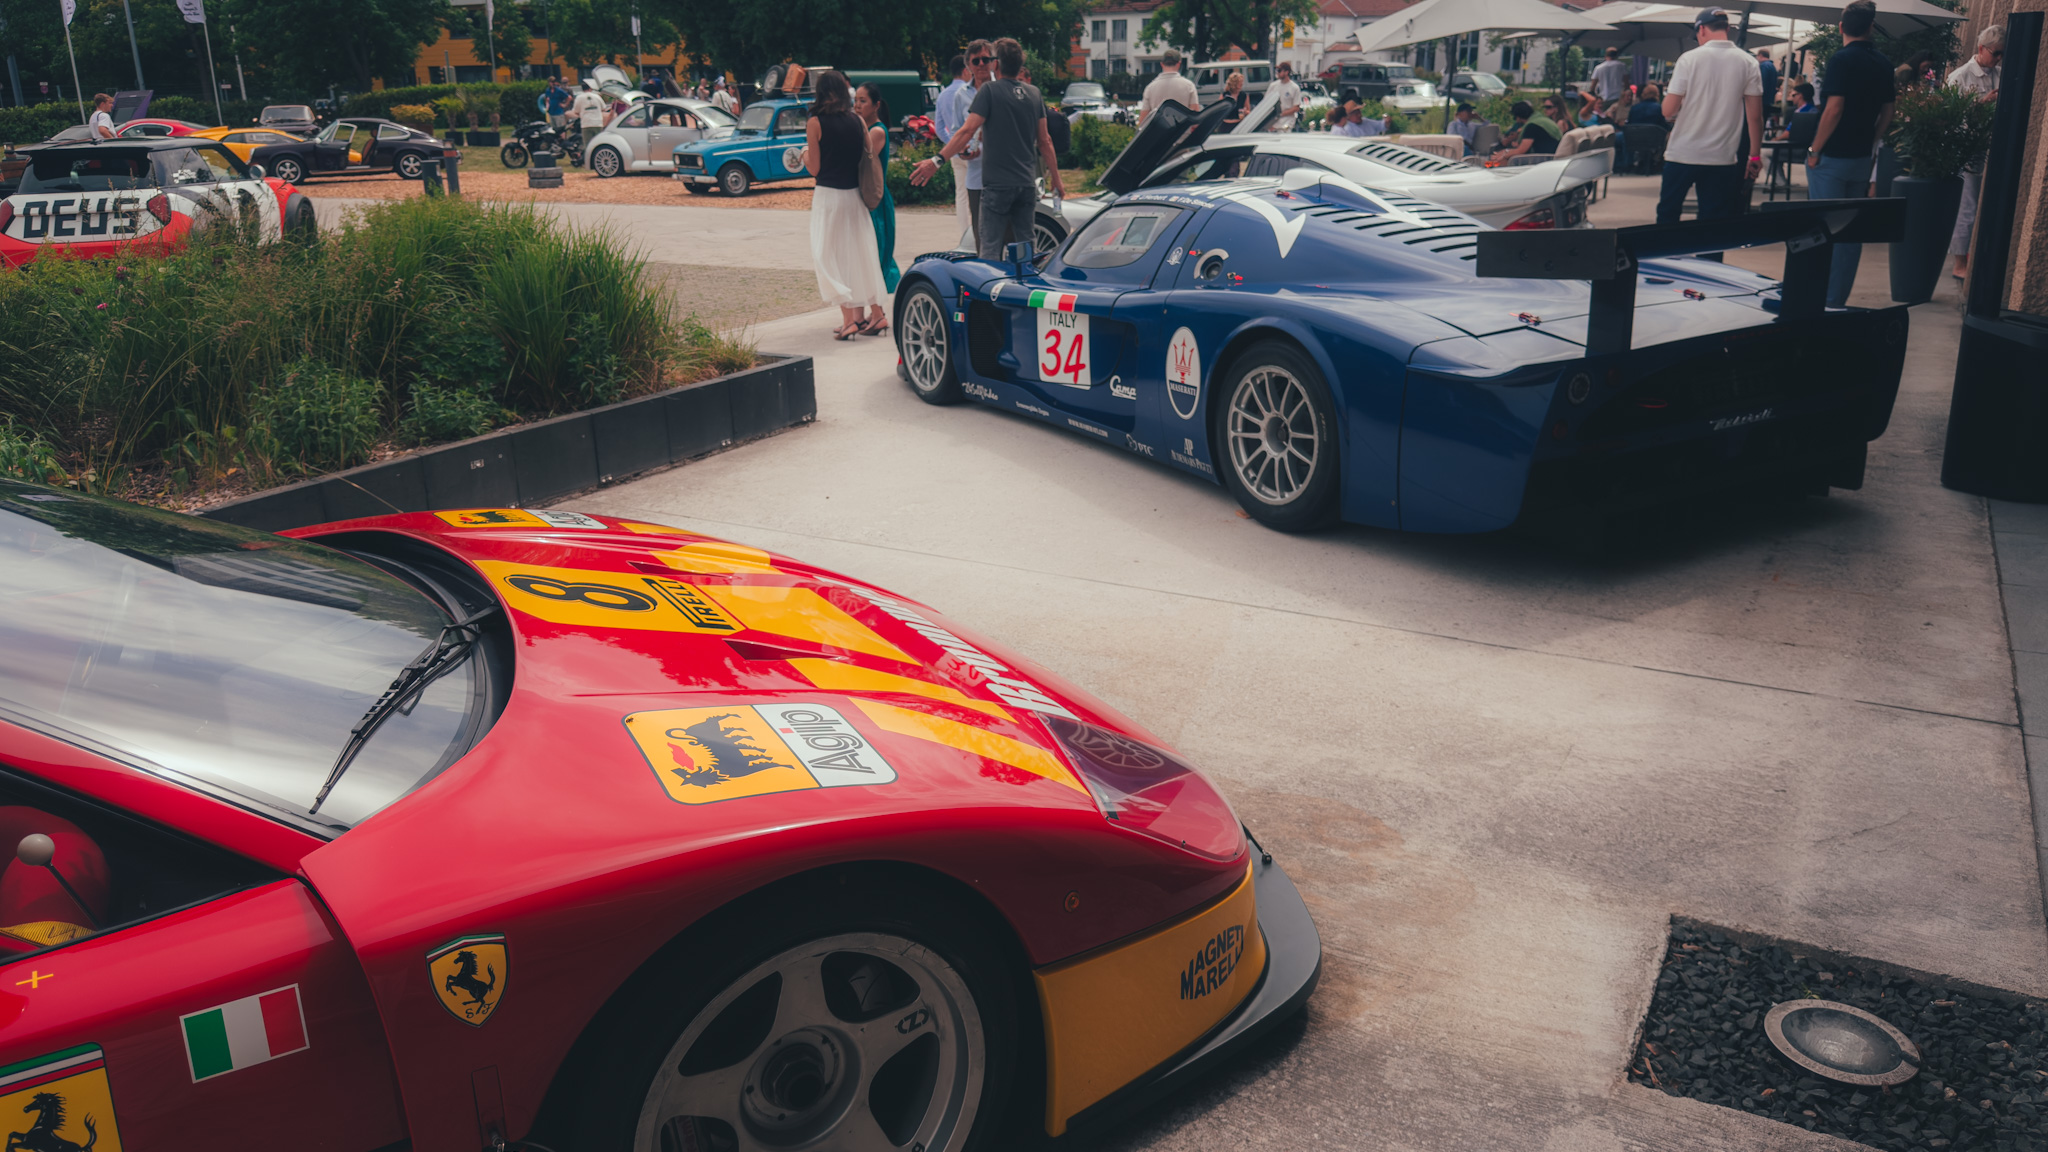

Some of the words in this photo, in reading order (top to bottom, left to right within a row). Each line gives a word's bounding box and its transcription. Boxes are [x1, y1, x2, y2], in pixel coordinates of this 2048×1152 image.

[23, 197, 140, 239] DEUS
[1049, 311, 1077, 329] ITALY
[1041, 329, 1086, 385] 34
[1169, 381, 1197, 397] MASERATI
[504, 574, 658, 612] 8
[642, 578, 736, 631] PIRELLI
[780, 709, 877, 775] Agip
[465, 1008, 475, 1019] S
